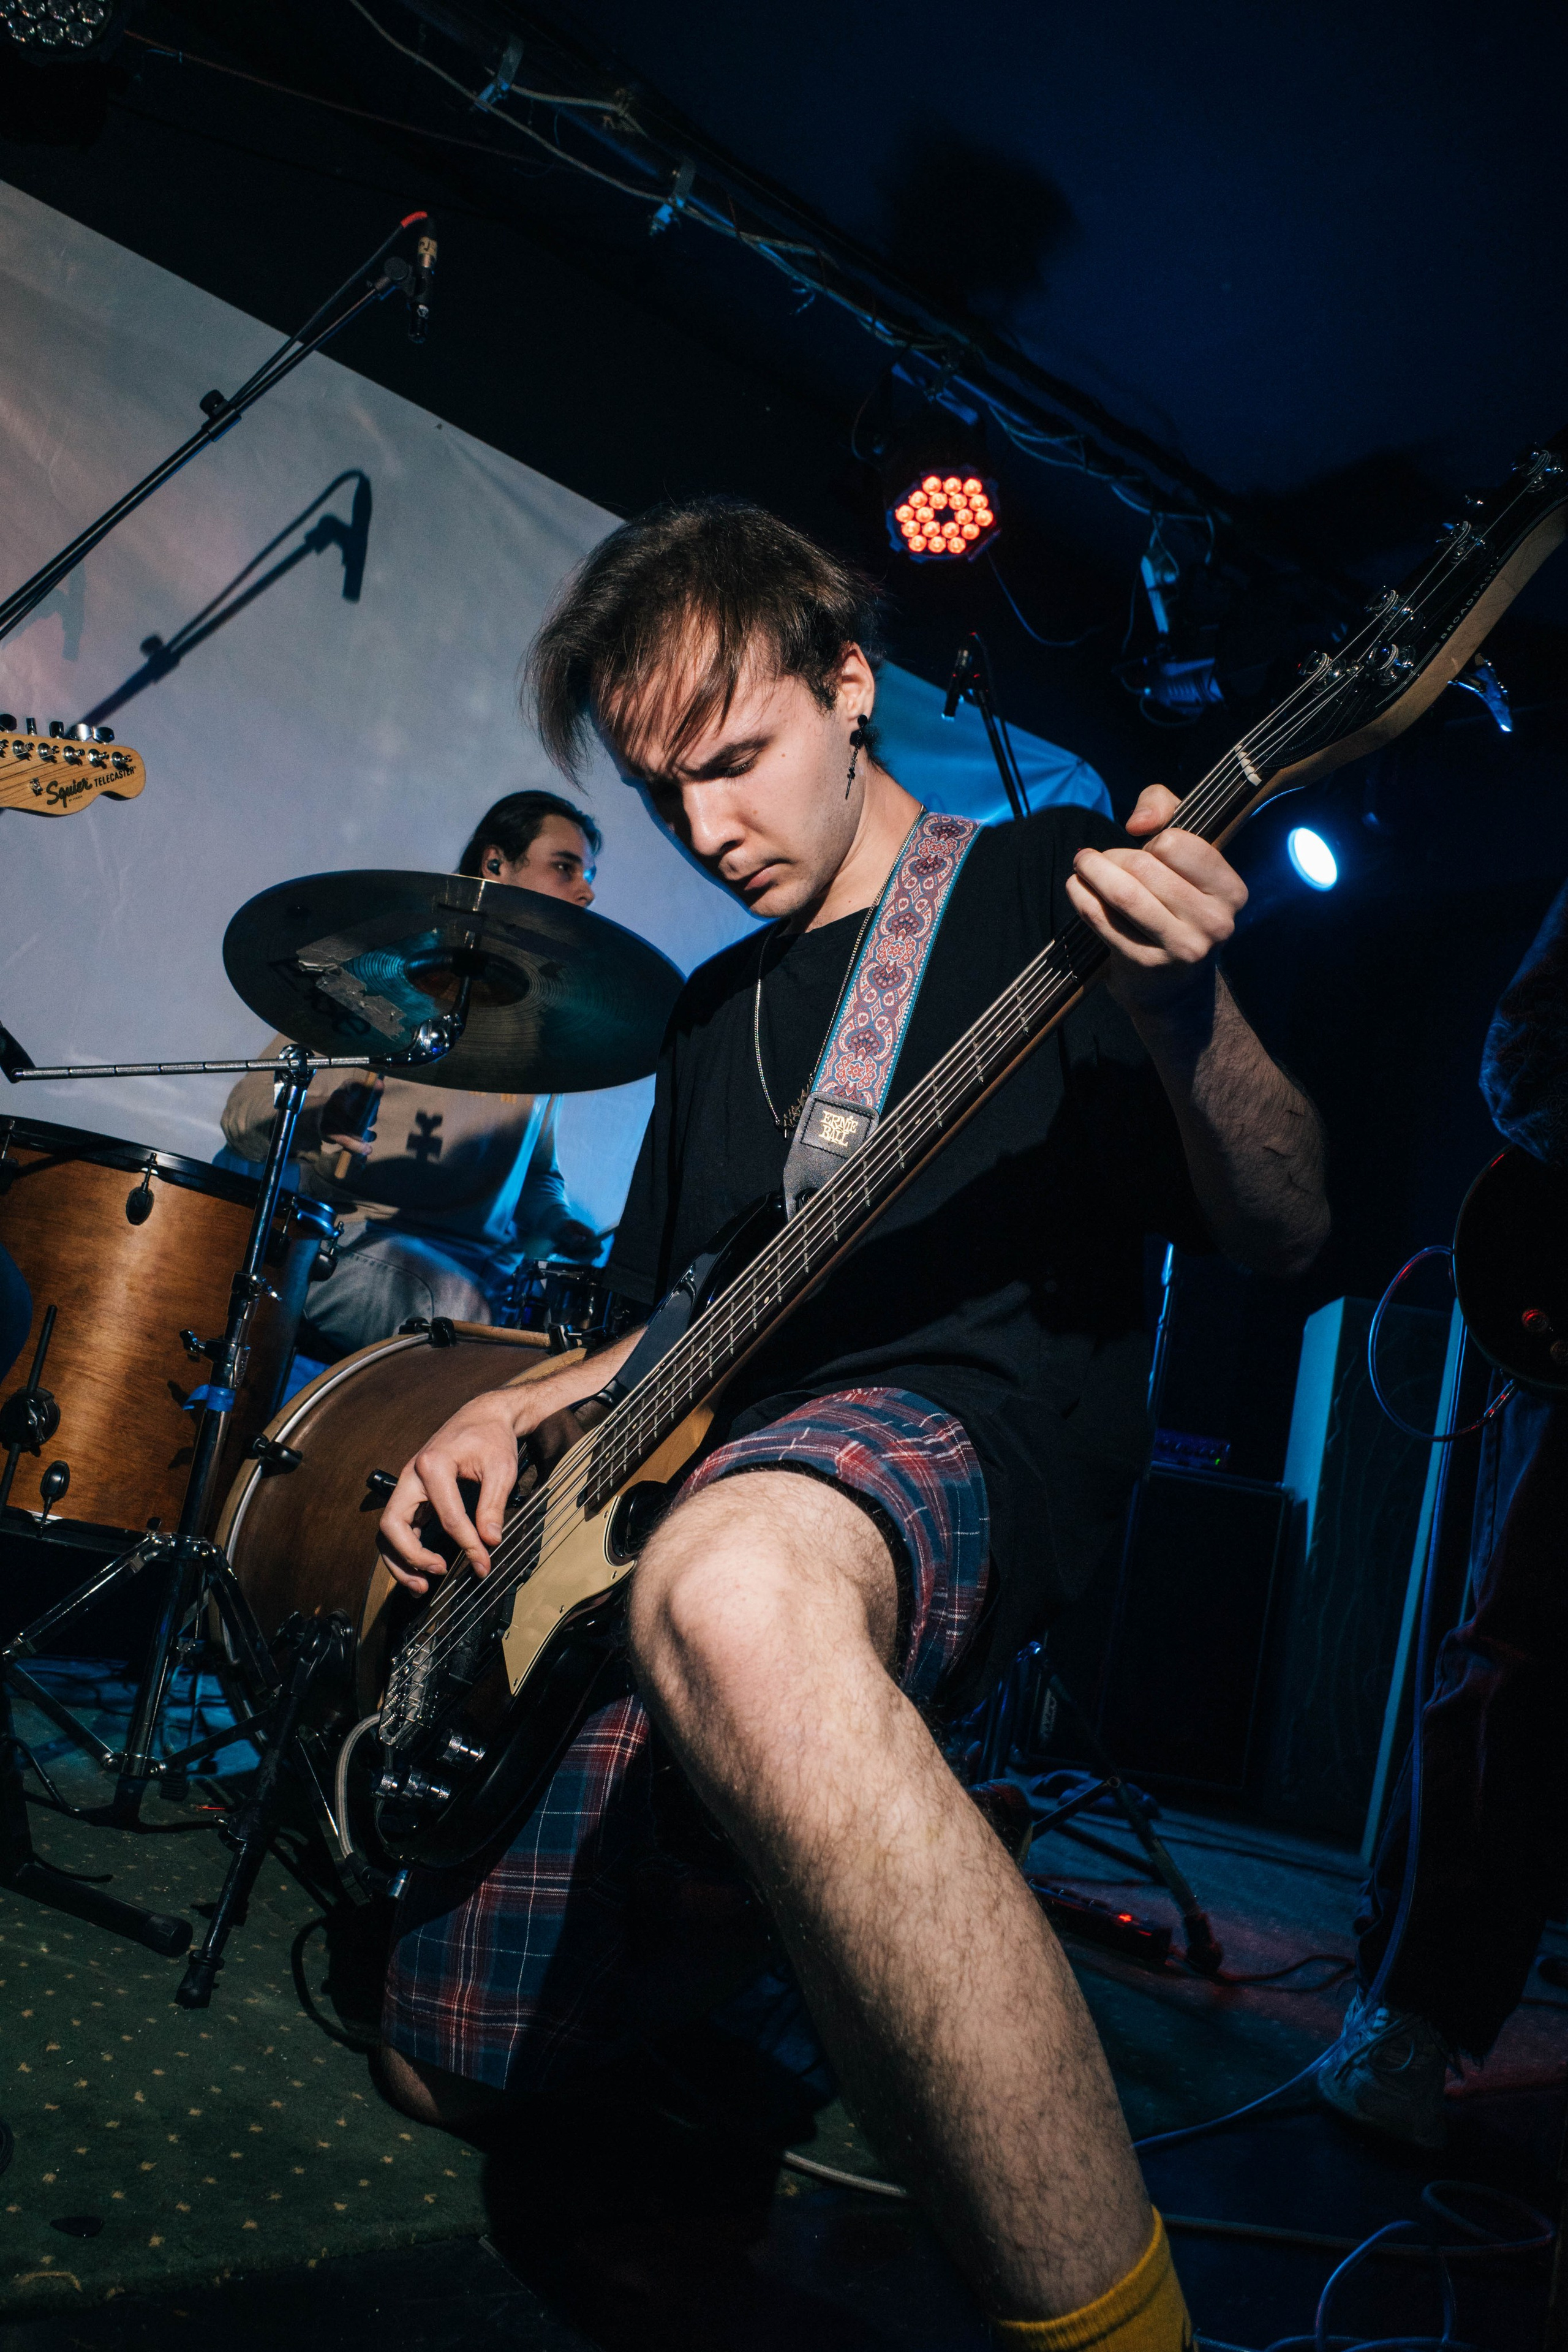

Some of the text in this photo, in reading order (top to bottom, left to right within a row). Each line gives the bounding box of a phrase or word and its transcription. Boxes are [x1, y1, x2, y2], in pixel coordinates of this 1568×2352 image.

[1440, 569, 1497, 639] BROADBASS
[46, 766, 135, 808] Squier TELECASTER
[818, 1124, 849, 1147] BALL
